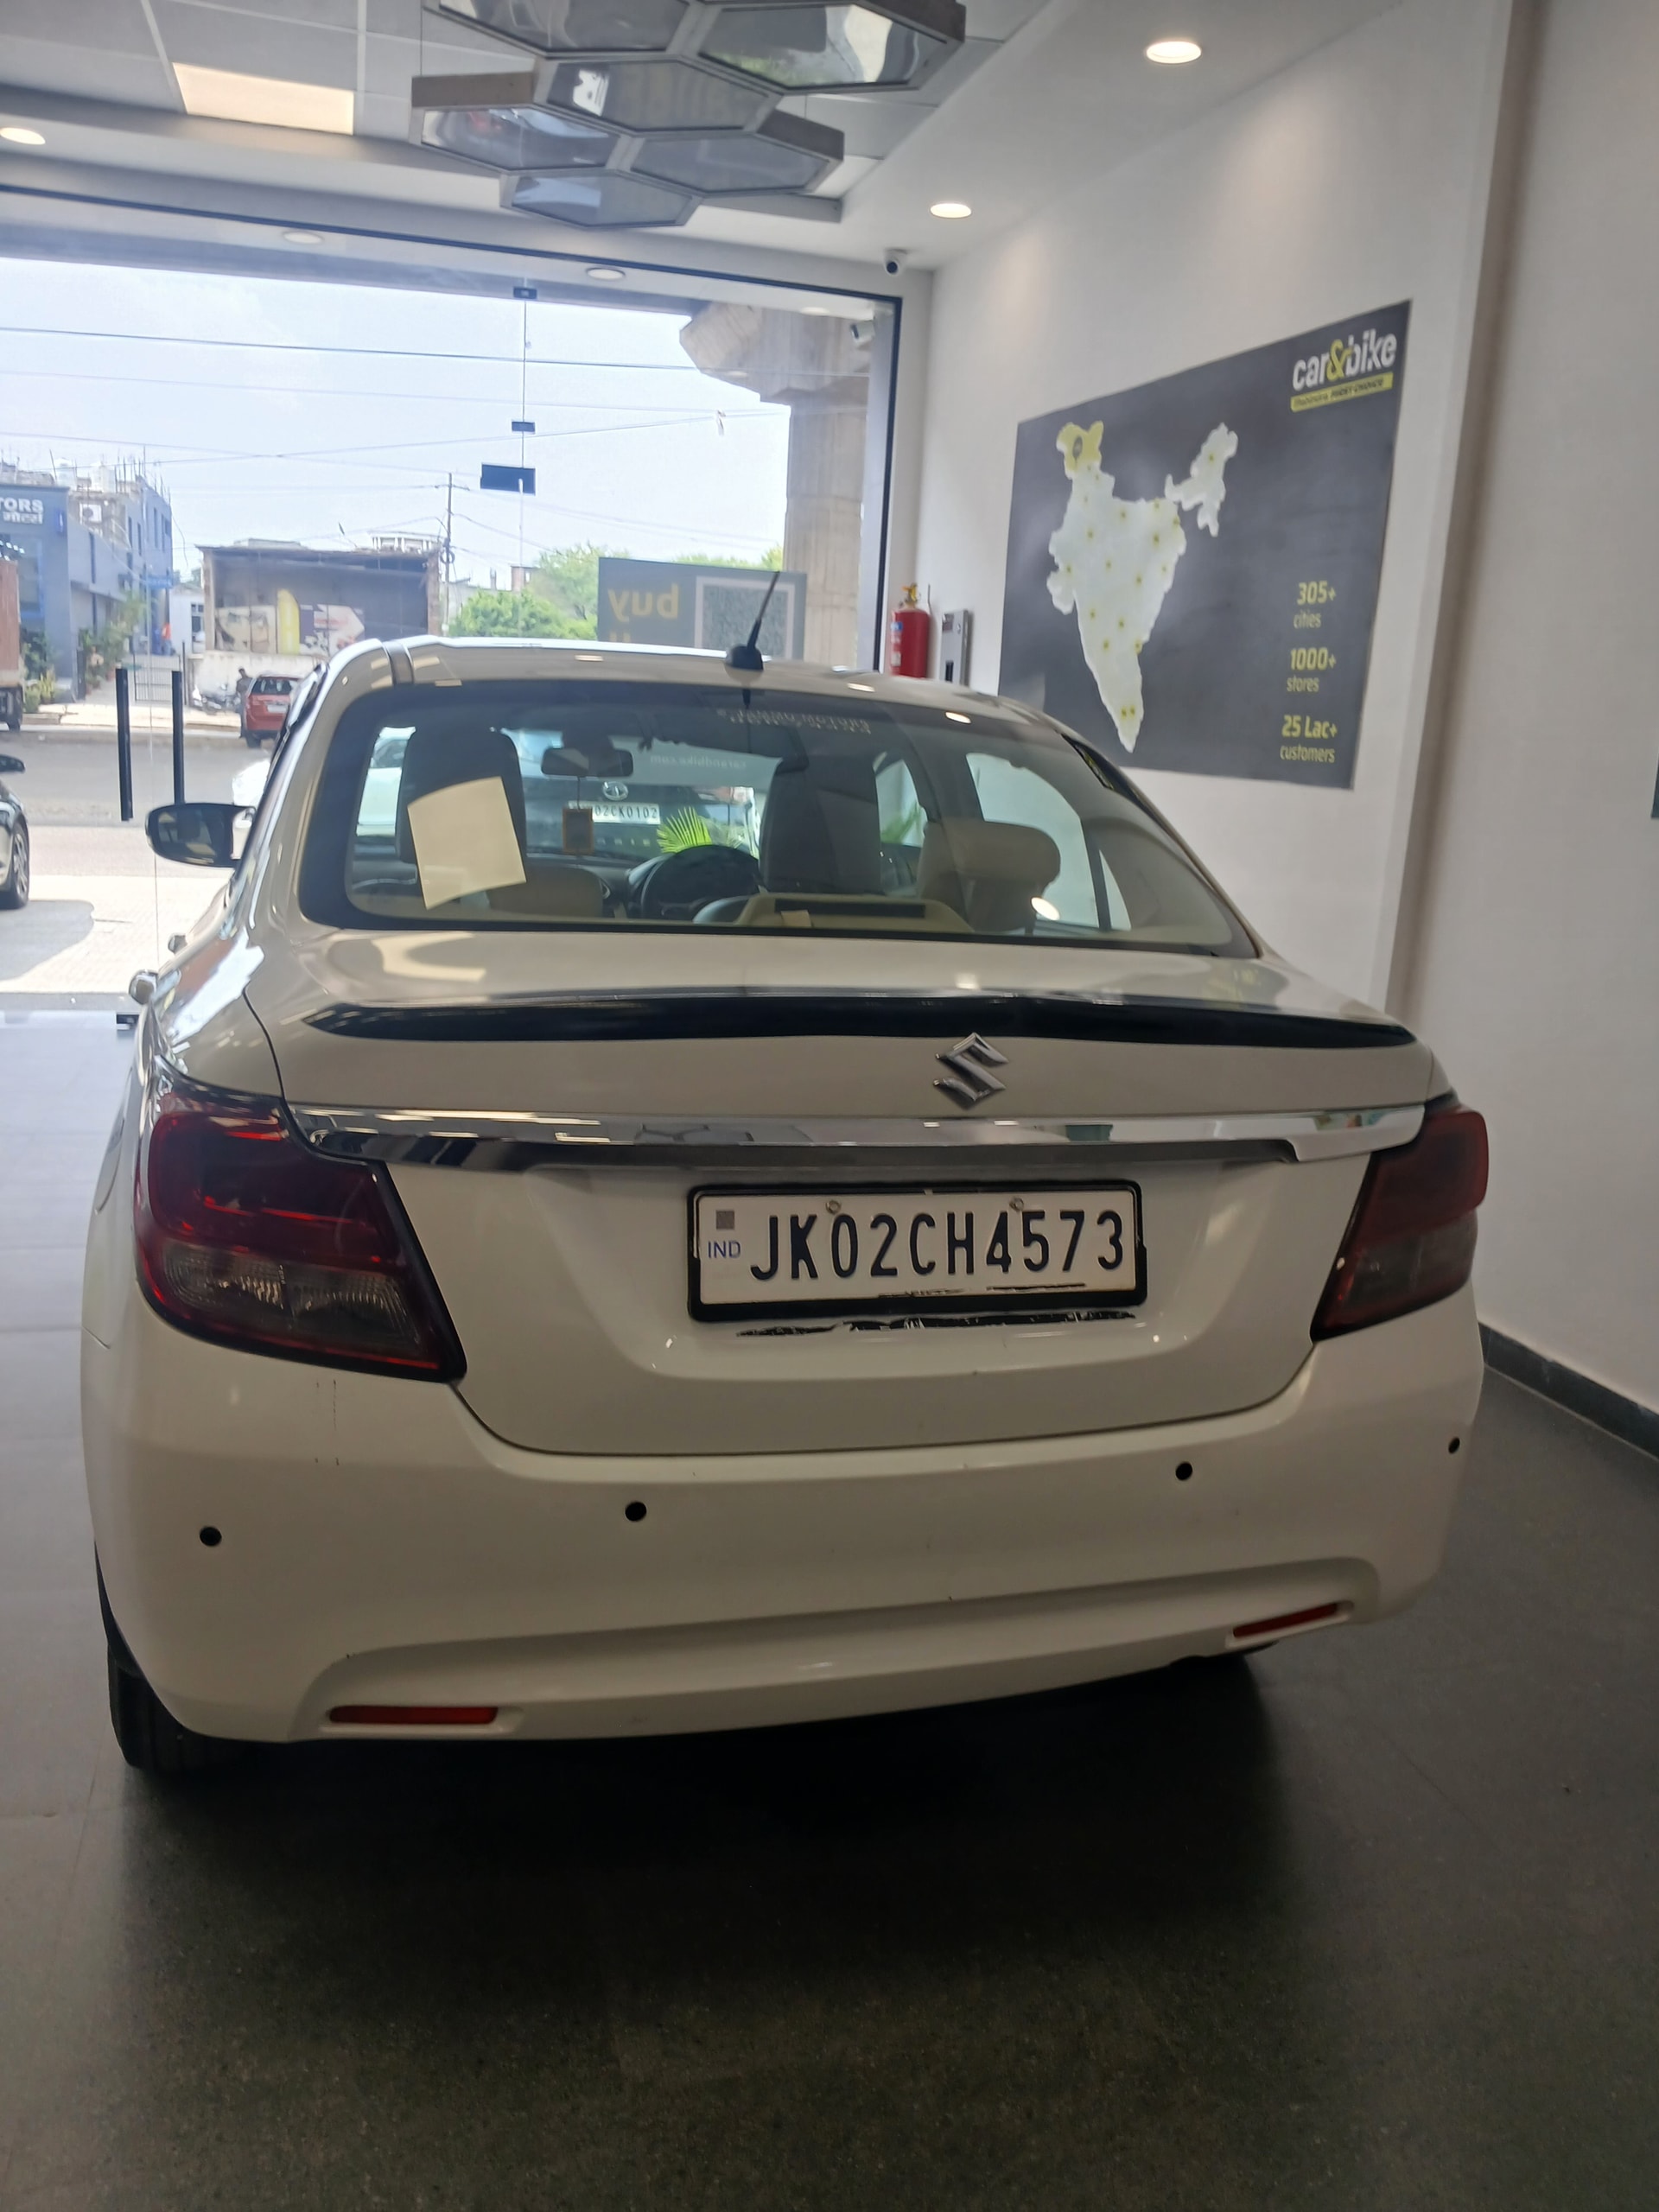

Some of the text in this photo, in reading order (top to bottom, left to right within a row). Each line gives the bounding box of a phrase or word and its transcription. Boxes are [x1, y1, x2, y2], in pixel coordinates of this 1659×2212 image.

[1293, 328, 1397, 391] car&bike
[1297, 581, 1336, 605] 305+
[1293, 610, 1322, 629] cities
[1290, 647, 1337, 671] 1000+
[1287, 675, 1320, 692] stores
[1281, 715, 1338, 739] 25 Lac+
[1280, 744, 1336, 763] customers
[579, 804, 658, 819] 02CK0102
[708, 1241, 741, 1259] IND
[751, 1210, 1124, 1281] JK02CH4573
